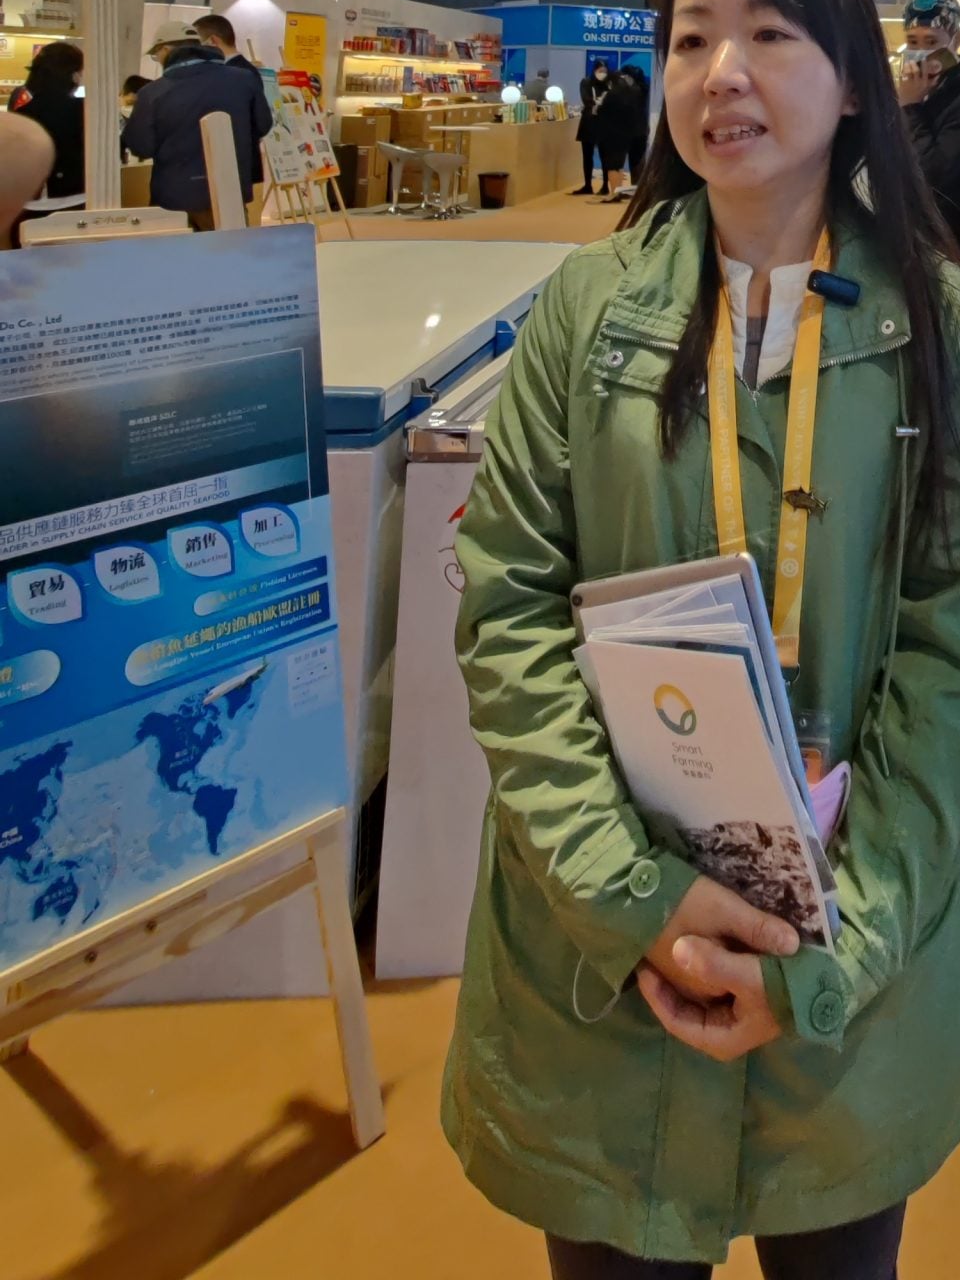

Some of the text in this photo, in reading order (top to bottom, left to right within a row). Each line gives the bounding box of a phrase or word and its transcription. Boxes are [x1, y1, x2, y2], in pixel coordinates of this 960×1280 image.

[583, 13, 656, 31] 现场办公室
[583, 32, 656, 45] ON-SITE OFFICE
[41, 530, 75, 545] SUPPLY
[78, 524, 106, 537] CHAIN
[108, 514, 144, 528] SERVICE
[157, 501, 191, 515] QUALITY
[193, 491, 230, 505] SEAFOOD
[253, 514, 283, 534] 加工
[186, 532, 216, 554] 銷售
[110, 553, 146, 575] 物流
[185, 552, 228, 569] Marketing
[29, 574, 65, 599] 貿易
[28, 600, 67, 616] Trading
[672, 741, 703, 756] Smart
[672, 754, 714, 772] Farming
